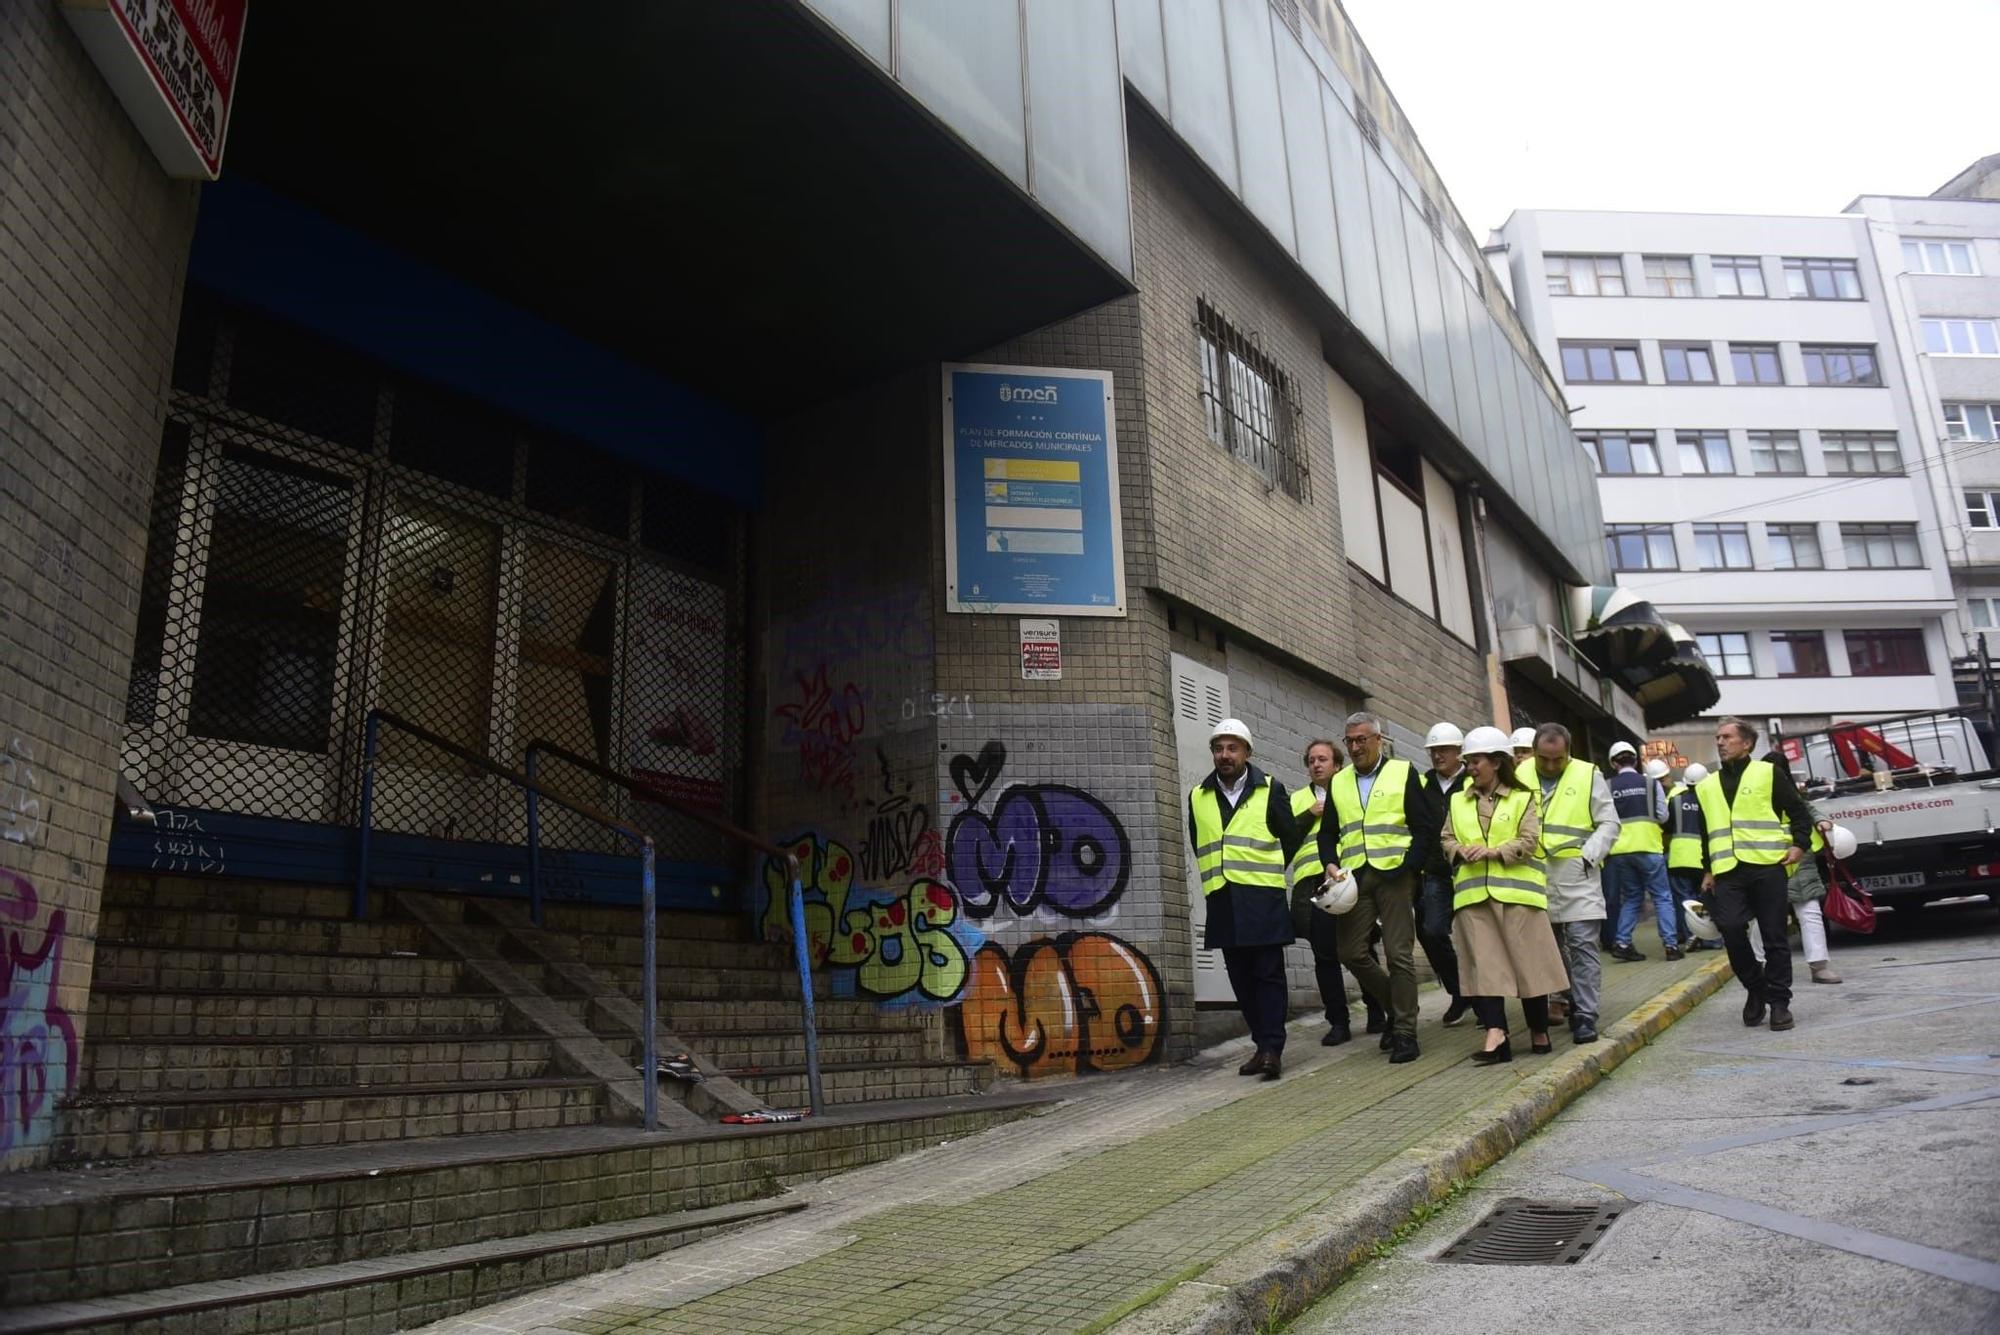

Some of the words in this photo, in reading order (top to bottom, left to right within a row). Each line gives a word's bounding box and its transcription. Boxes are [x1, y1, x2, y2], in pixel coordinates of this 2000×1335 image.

[158, 0, 181, 38] FE
[183, 35, 214, 100] BAR
[154, 10, 215, 140] PLAZA
[142, 27, 187, 109] DESAYUNOS
[187, 102, 194, 118] Y
[193, 113, 214, 154] TAPAS
[960, 428, 982, 437] PLAN
[984, 429, 996, 437] DE
[997, 428, 1052, 439] FORMACIÓN
[970, 439, 982, 448] DE
[984, 440, 1033, 450] MERCADOS
[1035, 442, 1092, 452] MUNICIPALES
[1024, 644, 1058, 652] Alarma
[1646, 740, 1679, 756] ERIA
[1829, 798, 1954, 821] soteganoroeste.com
